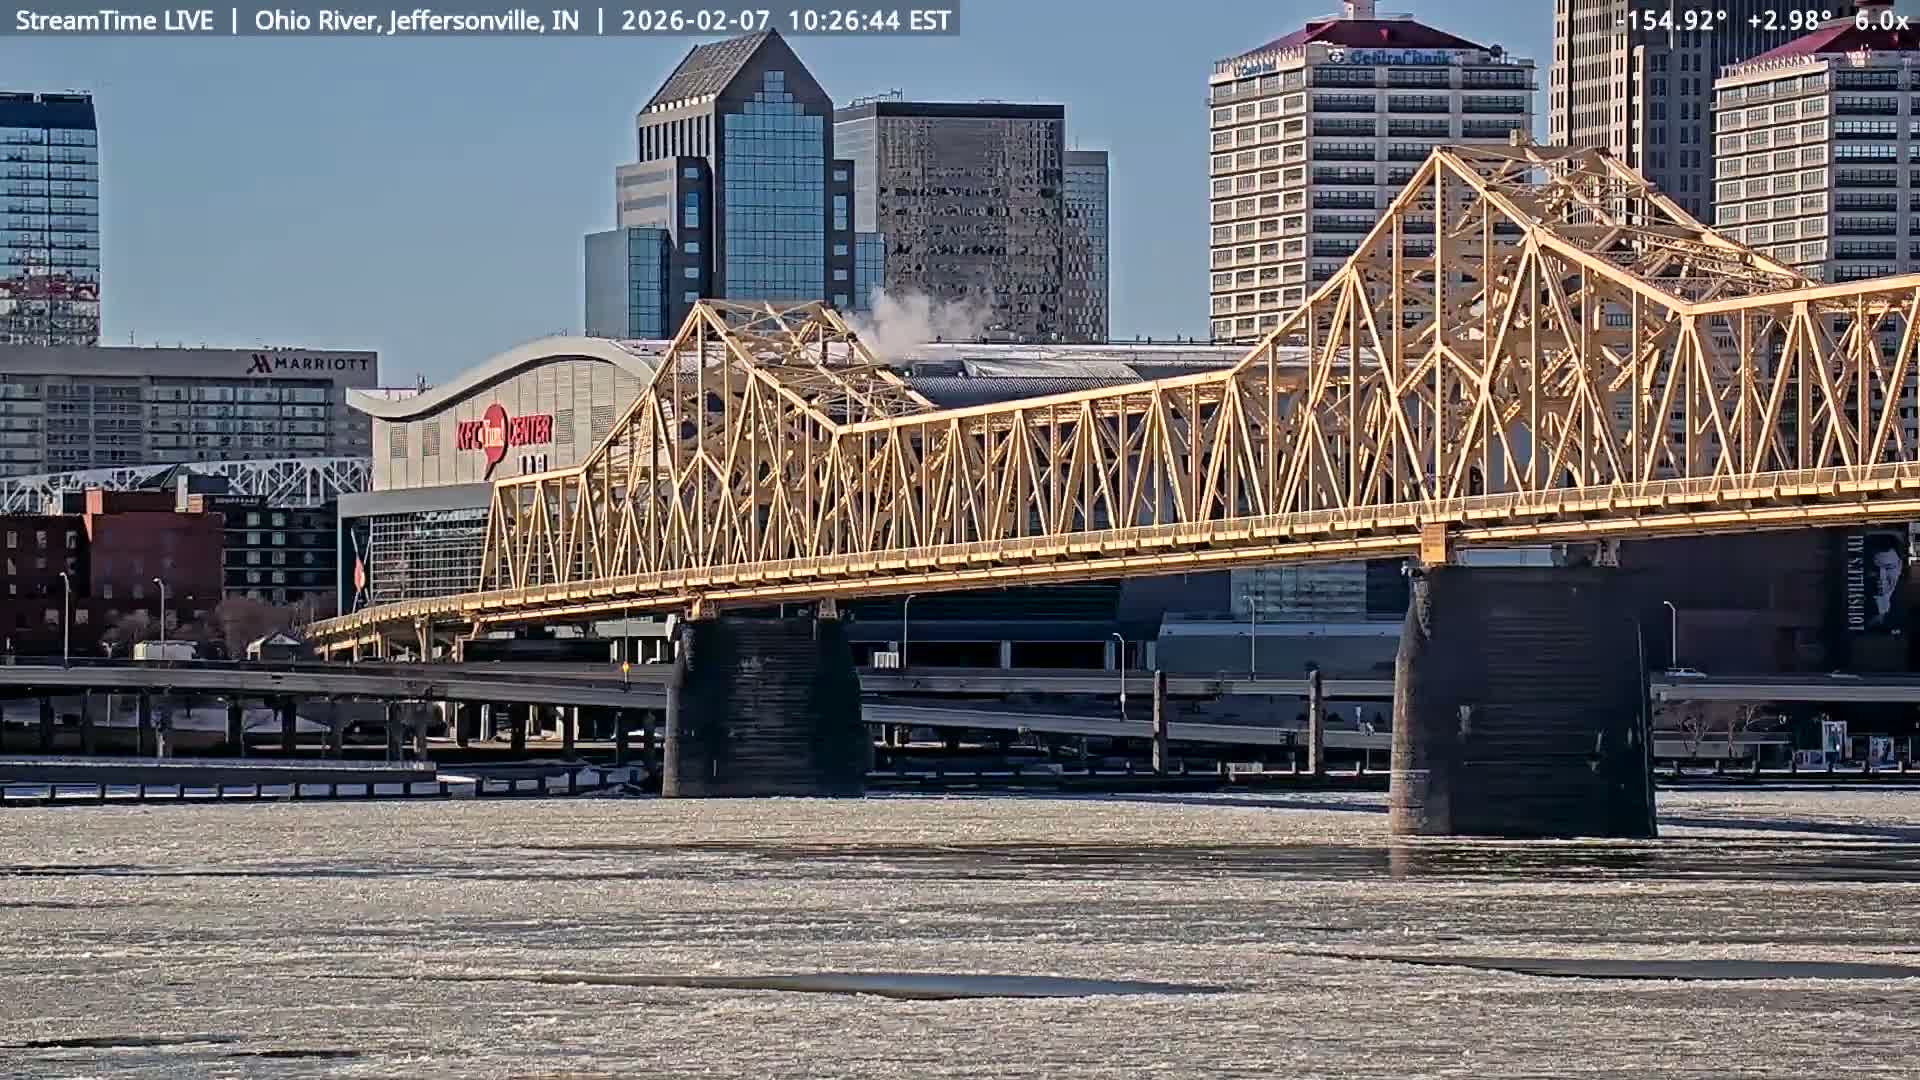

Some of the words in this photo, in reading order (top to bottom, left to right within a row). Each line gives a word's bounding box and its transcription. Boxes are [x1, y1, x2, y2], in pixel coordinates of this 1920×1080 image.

[275, 357, 369, 371] MARRIOTT
[456, 420, 484, 451] KFC
[510, 414, 554, 449] CENTER
[1847, 535, 1865, 554] ALI
